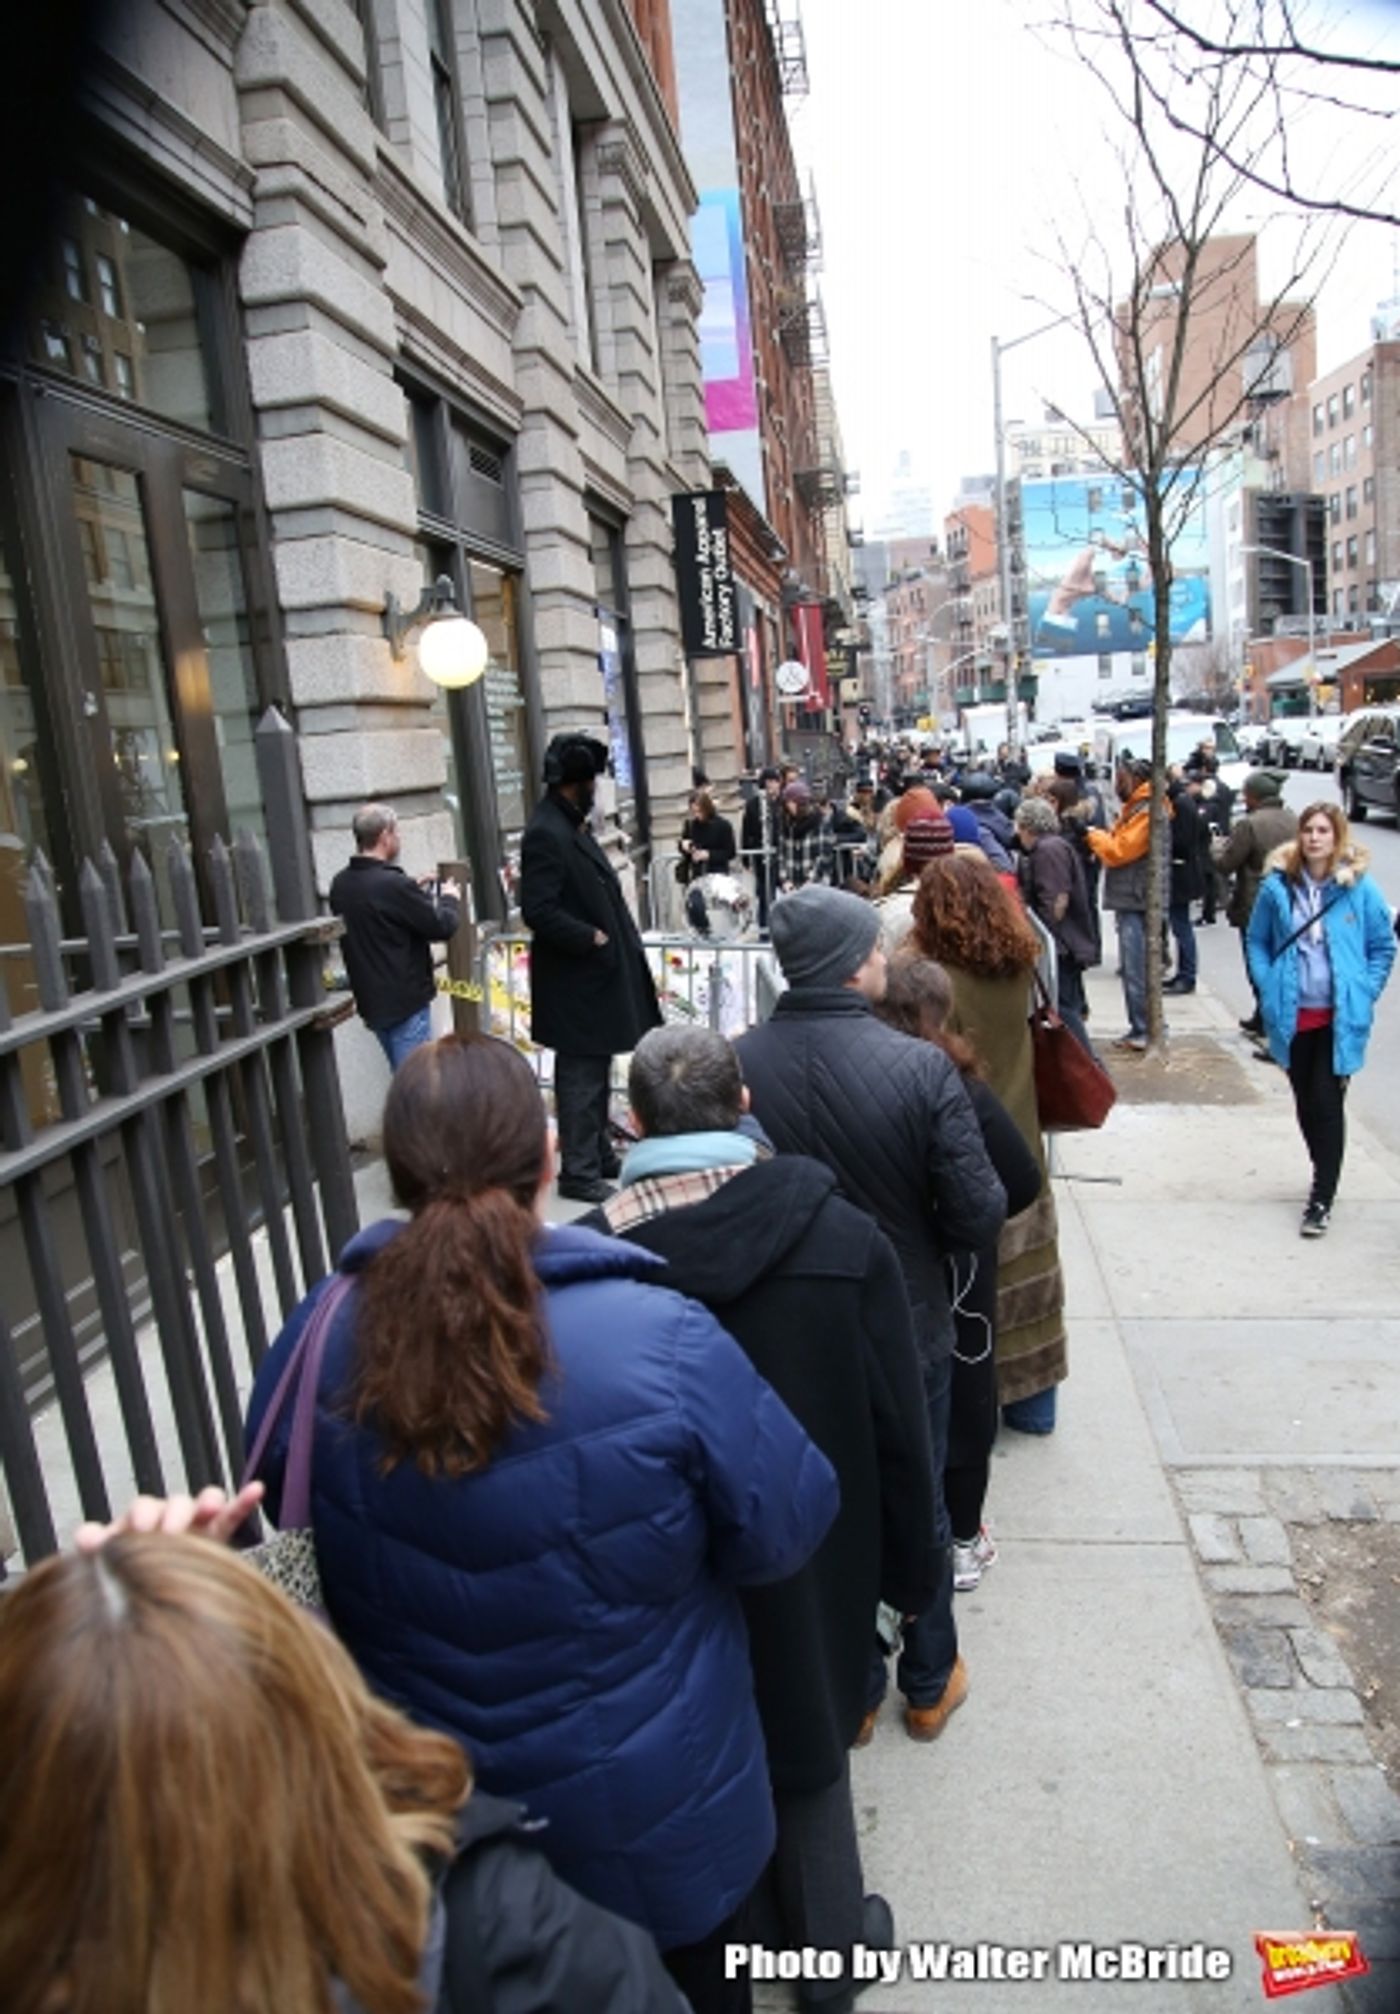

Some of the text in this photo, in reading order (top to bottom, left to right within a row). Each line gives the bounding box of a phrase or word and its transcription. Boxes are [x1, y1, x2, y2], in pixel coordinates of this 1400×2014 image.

[691, 497, 717, 649] American Apparel
[718, 584, 734, 649] Factory
